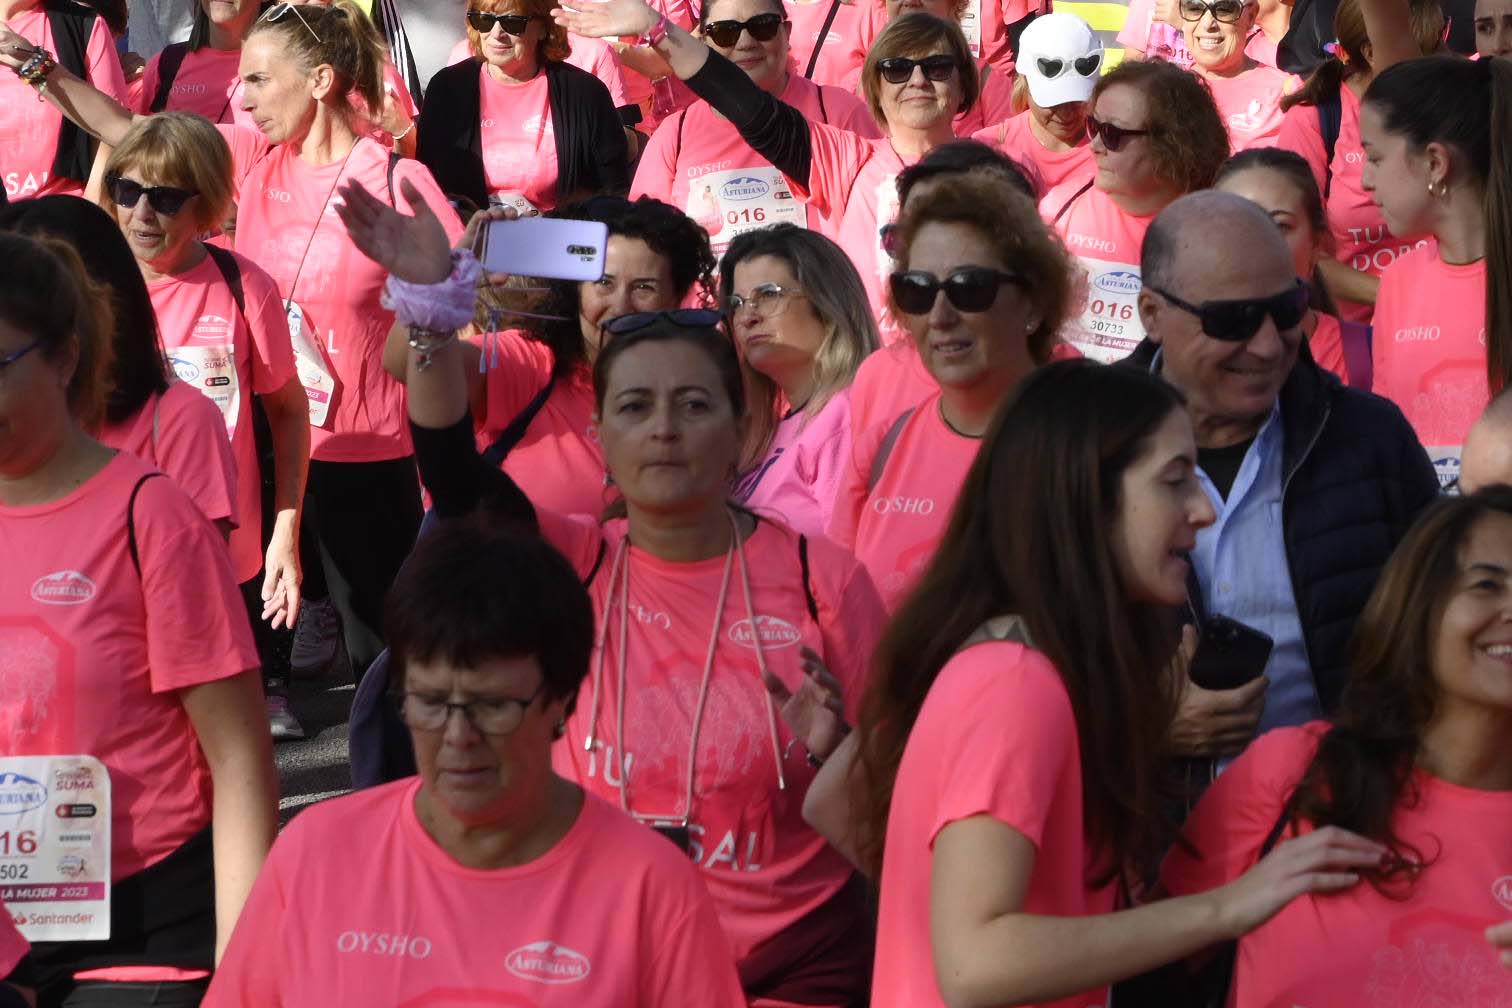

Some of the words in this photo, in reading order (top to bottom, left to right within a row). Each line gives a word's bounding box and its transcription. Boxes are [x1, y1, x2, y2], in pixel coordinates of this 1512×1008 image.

[687, 160, 732, 178] OYSHO
[723, 186, 767, 198] ASTURIANA
[727, 207, 767, 225] 016
[1067, 233, 1117, 254] OYSHO
[1347, 225, 1383, 246] TU
[1090, 299, 1134, 320] 016
[1089, 320, 1124, 335] 30733
[873, 495, 936, 516] OSHO
[56, 780, 95, 791] SUMA
[16, 887, 57, 899] MUJER
[61, 886, 90, 898] 2023
[29, 912, 96, 926] Santander
[336, 930, 432, 960] OYSHO
[512, 956, 586, 976] ASTURIANA
